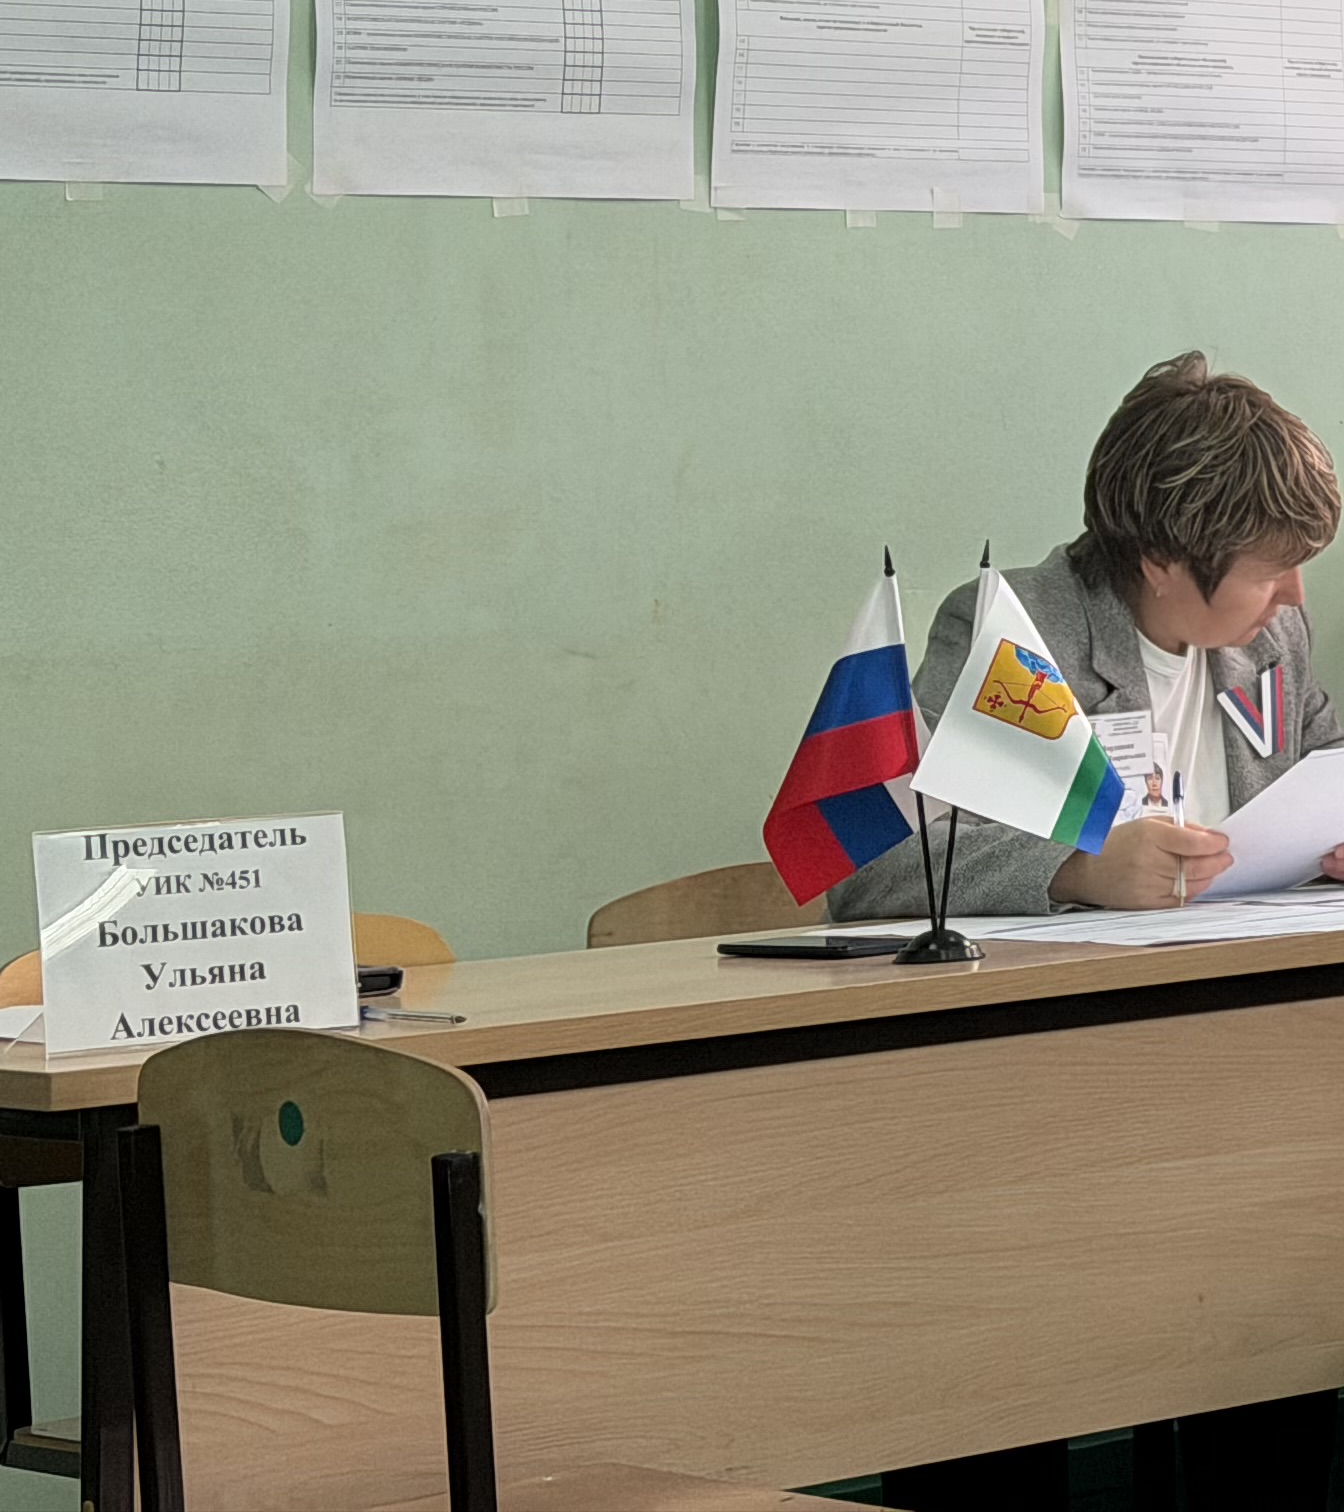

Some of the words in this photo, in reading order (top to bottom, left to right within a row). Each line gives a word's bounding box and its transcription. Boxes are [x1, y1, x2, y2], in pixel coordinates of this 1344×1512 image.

[82, 826, 307, 866] Председатель
[135, 873, 192, 898] УИК
[198, 869, 262, 892] №451
[97, 912, 303, 948] Большакова
[140, 960, 266, 990] Ульяна
[110, 1003, 301, 1040] Алексеевна
